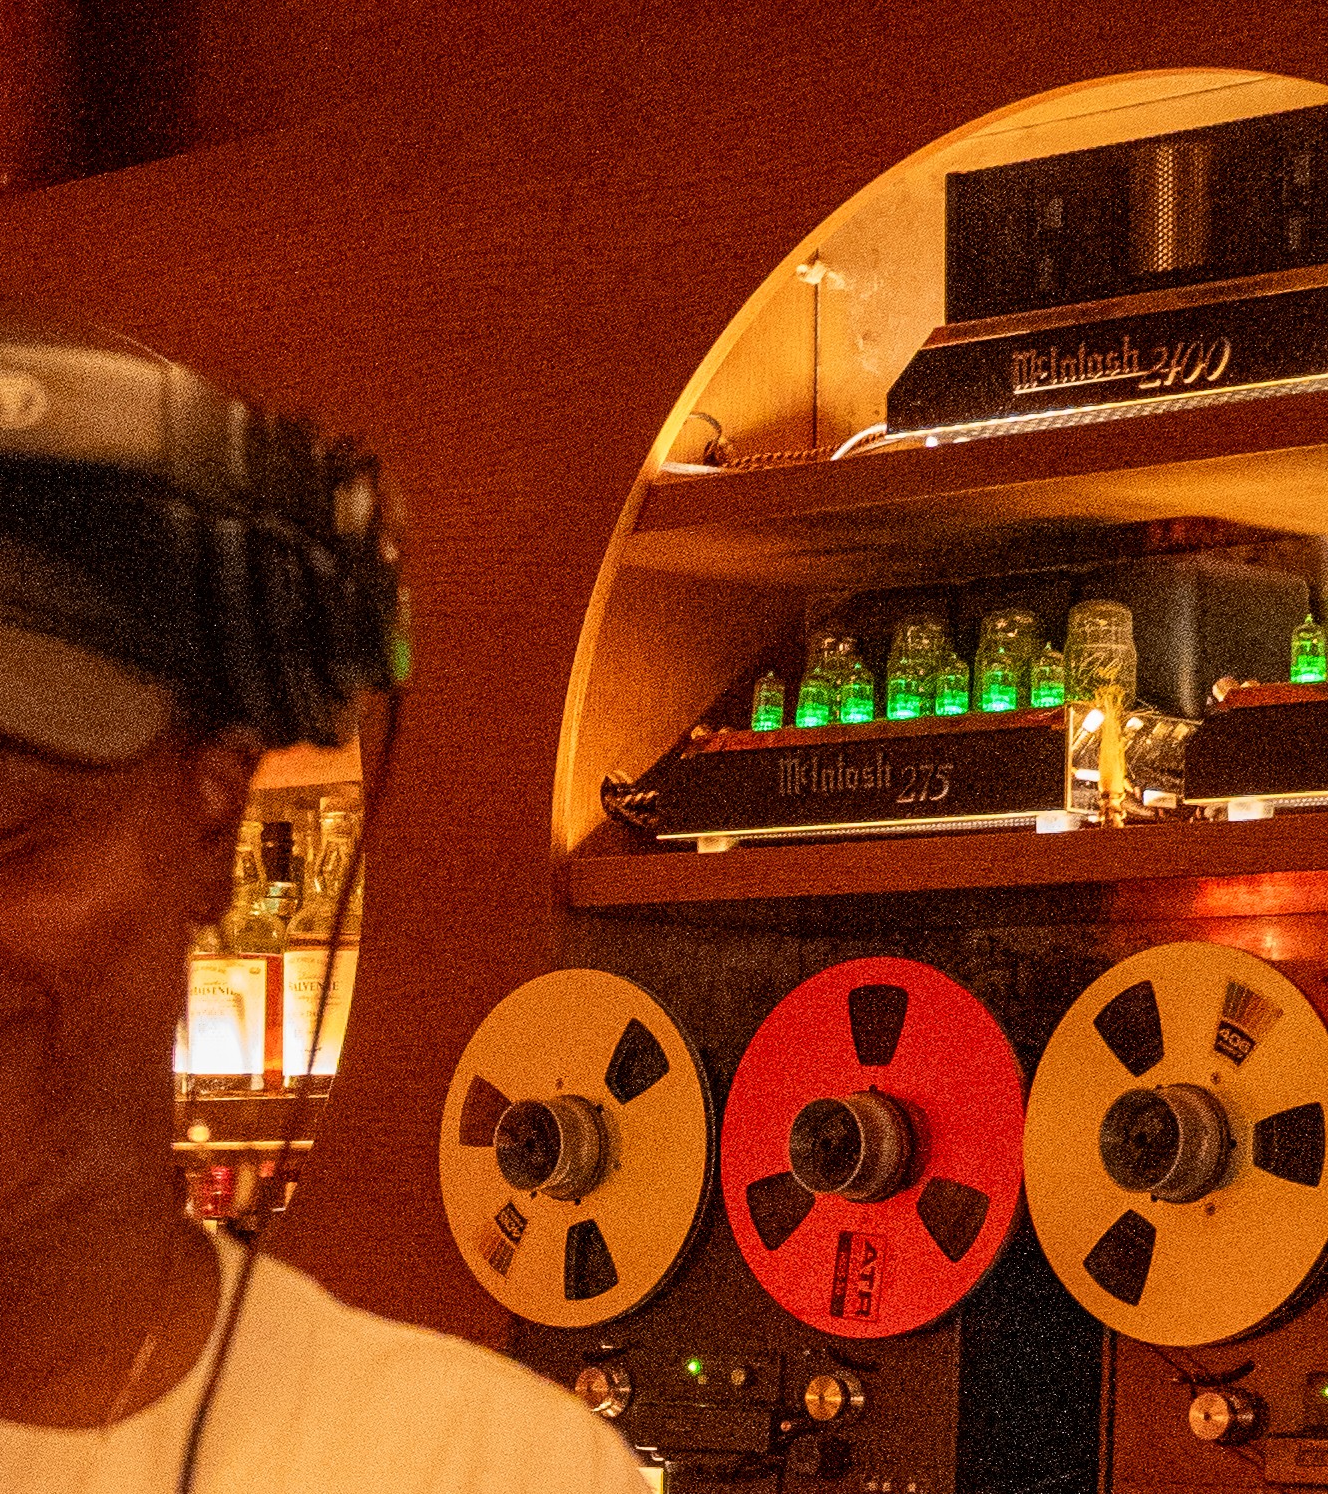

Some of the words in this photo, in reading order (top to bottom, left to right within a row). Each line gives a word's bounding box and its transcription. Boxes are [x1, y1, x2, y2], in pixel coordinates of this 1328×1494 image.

[1013, 335, 1140, 393] McIntosh
[778, 752, 892, 796] McIntosh
[896, 764, 954, 804] 275
[856, 1238, 879, 1317] ATR
